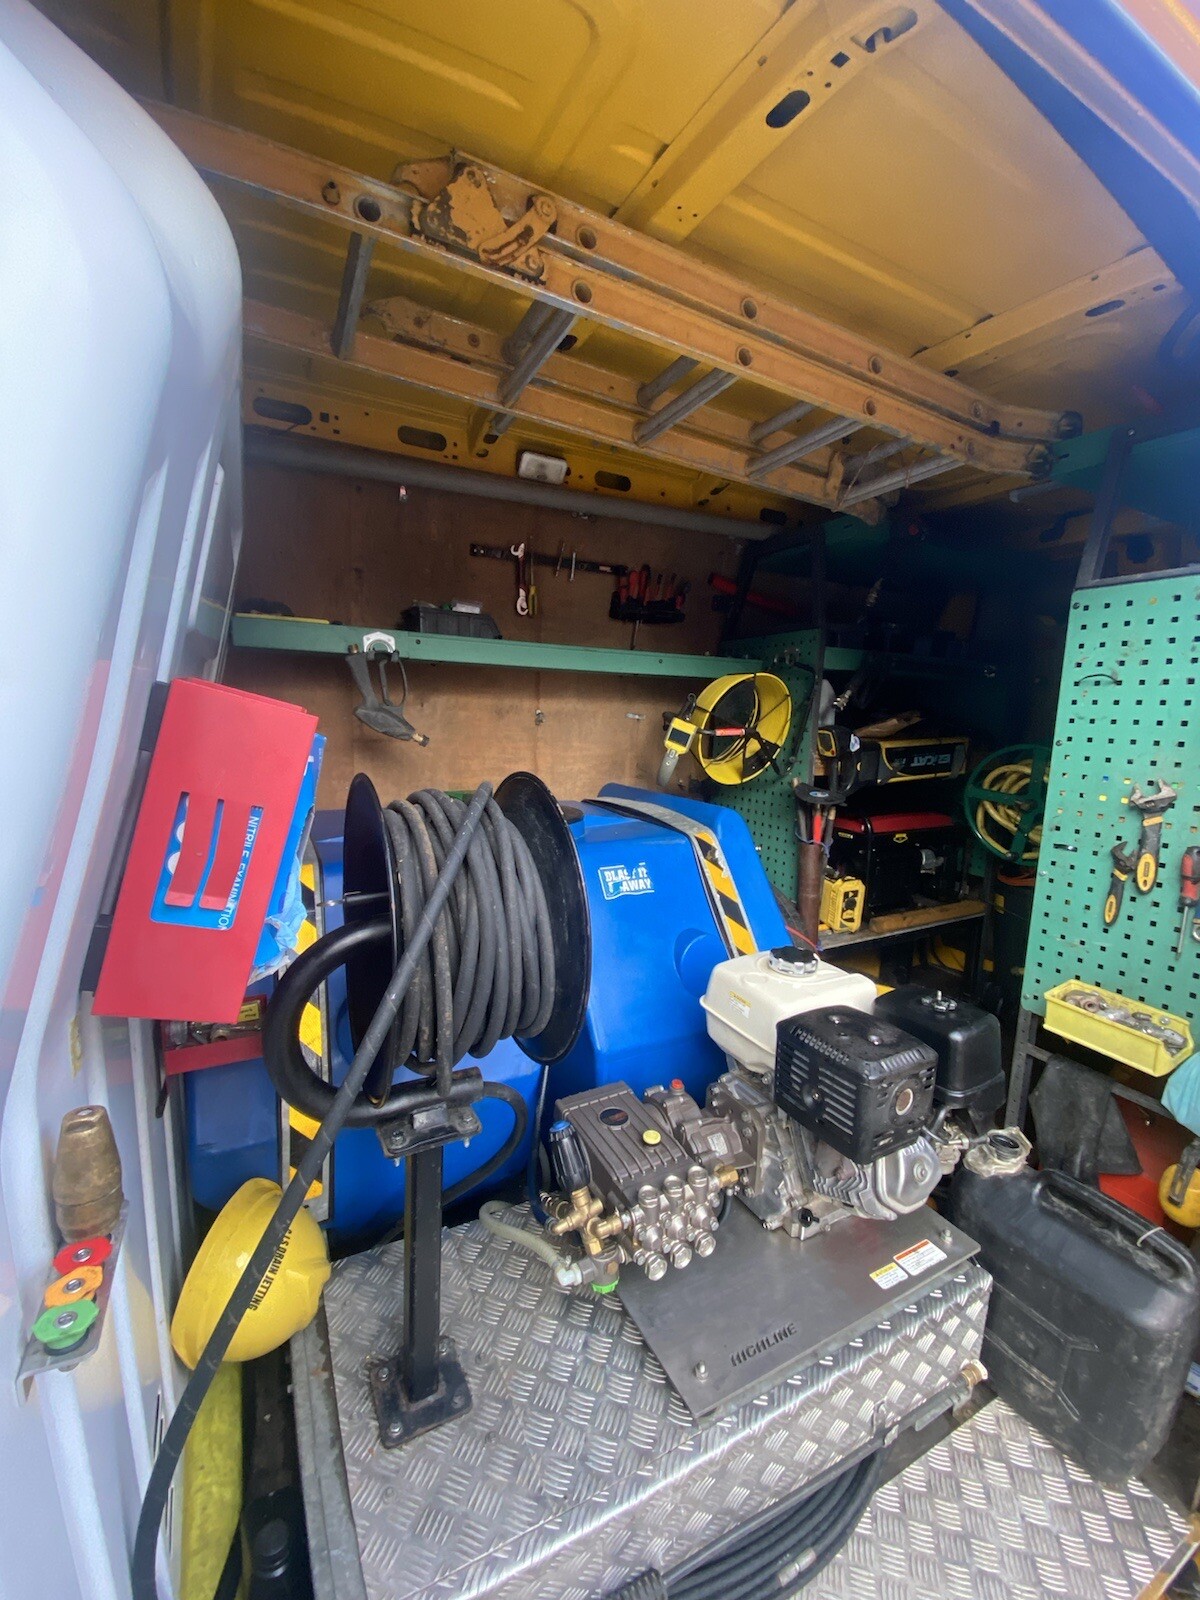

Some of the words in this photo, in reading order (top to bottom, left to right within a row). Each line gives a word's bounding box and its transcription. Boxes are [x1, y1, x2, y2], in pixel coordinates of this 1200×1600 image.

[242, 816, 260, 857] NITRILE
[620, 878, 652, 892] AWAY
[268, 1246, 287, 1275] DRAIN
[249, 1275, 274, 1311] JETTING
[731, 1323, 797, 1367] HIGHLINE
